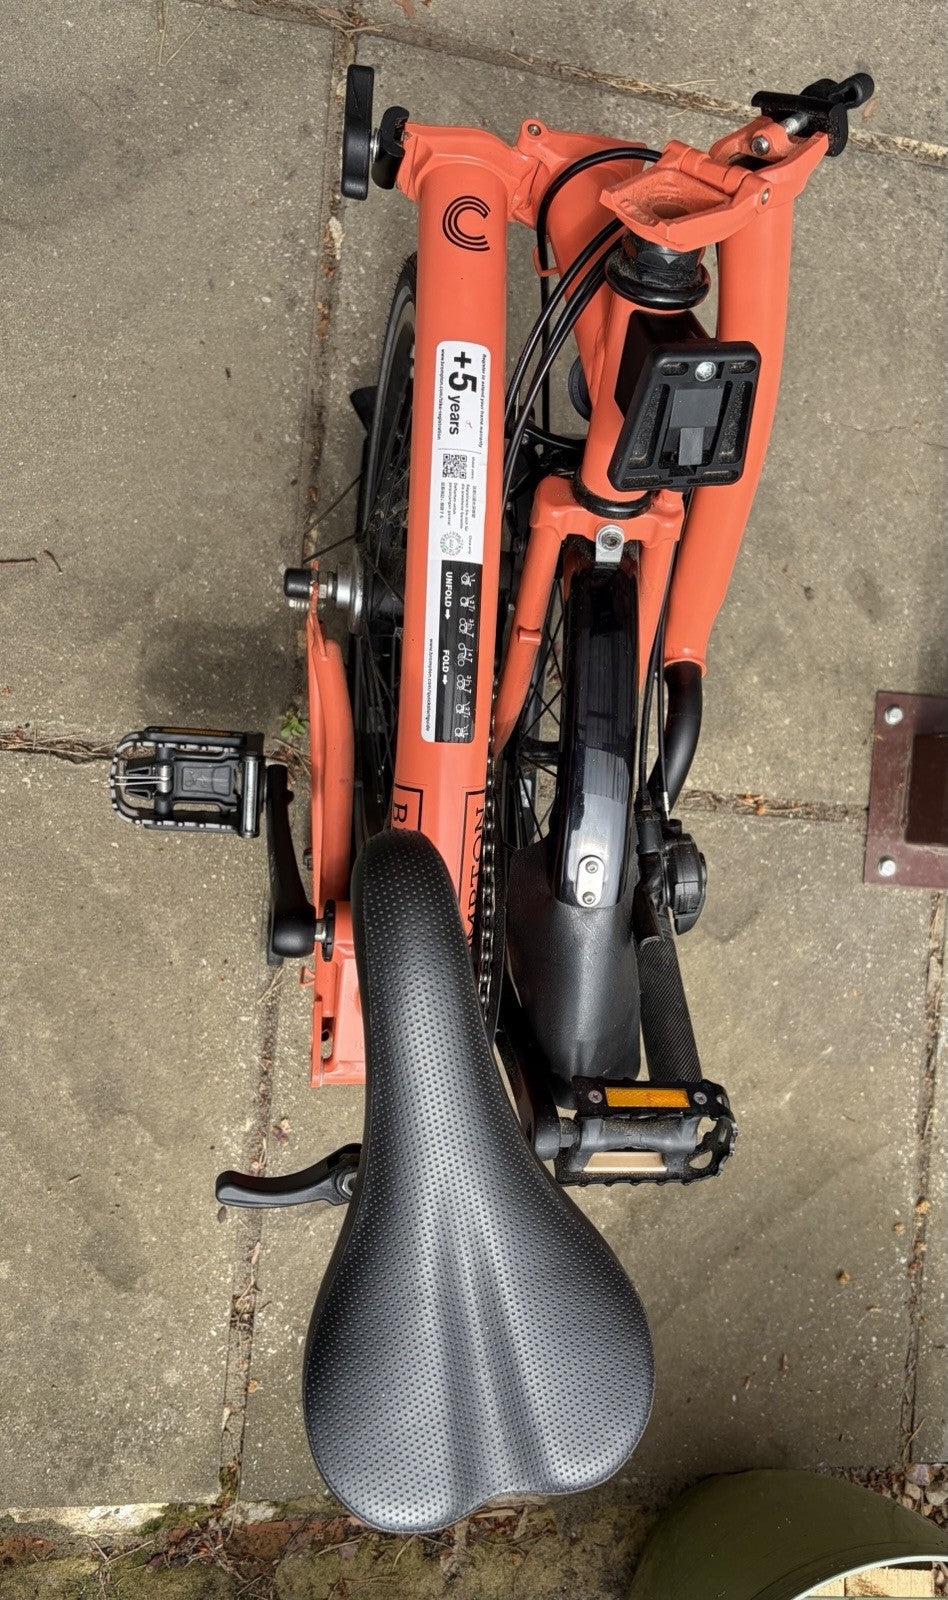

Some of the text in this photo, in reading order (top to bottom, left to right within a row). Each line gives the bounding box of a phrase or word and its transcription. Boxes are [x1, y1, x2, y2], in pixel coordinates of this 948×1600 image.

[436, 348, 445, 440] www.brompton.com/bike-registration
[448, 395, 460, 435] years
[444, 571, 453, 608] UNFOLD
